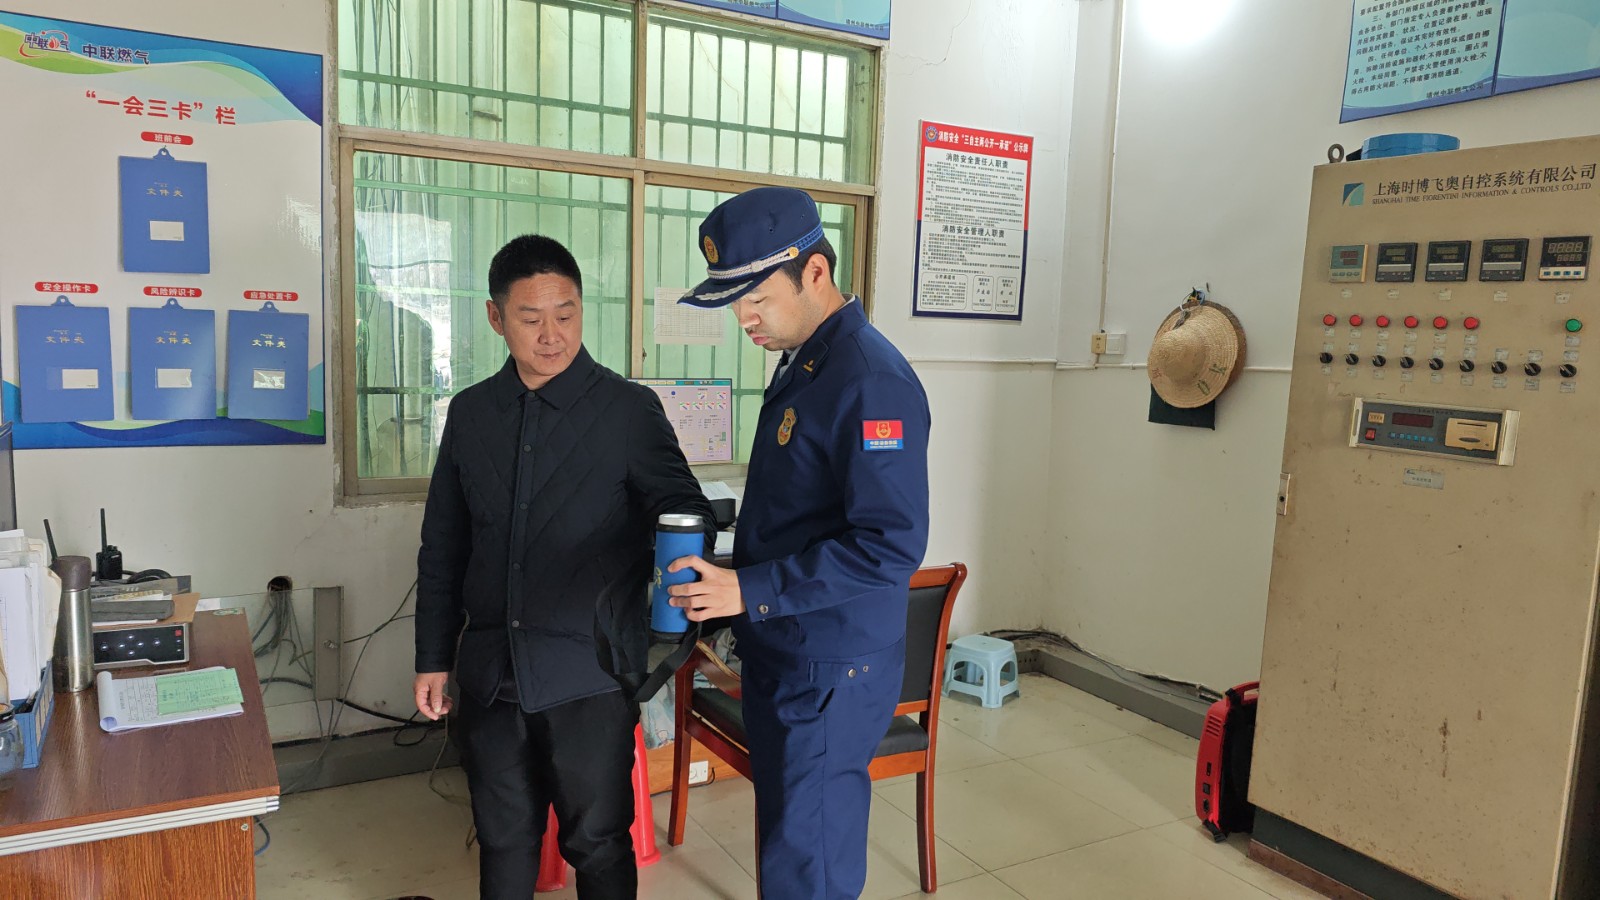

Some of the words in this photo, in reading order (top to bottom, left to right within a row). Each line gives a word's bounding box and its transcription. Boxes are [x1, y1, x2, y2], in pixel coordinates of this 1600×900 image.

[82, 43, 150, 65] 中联燃气
[154, 133, 182, 144] 班前会
[946, 153, 1008, 168] 消防安全责任人职责
[1373, 163, 1597, 197] 上海时博飞奥自控系统有限公司
[1372, 196, 1403, 205] SHANGHAI
[1405, 195, 1420, 203] TIME
[1461, 189, 1509, 199] INFORMATION
[1520, 184, 1559, 195] CONTROLS
[942, 224, 1005, 238] 消防安全管理人职责
[42, 282, 92, 294] 安全操作卡
[150, 286, 196, 297] 风险辨识卡
[250, 291, 293, 301] 应急处置卡
[155, 336, 192, 345] 文件夹
[252, 339, 287, 349] 文件夹
